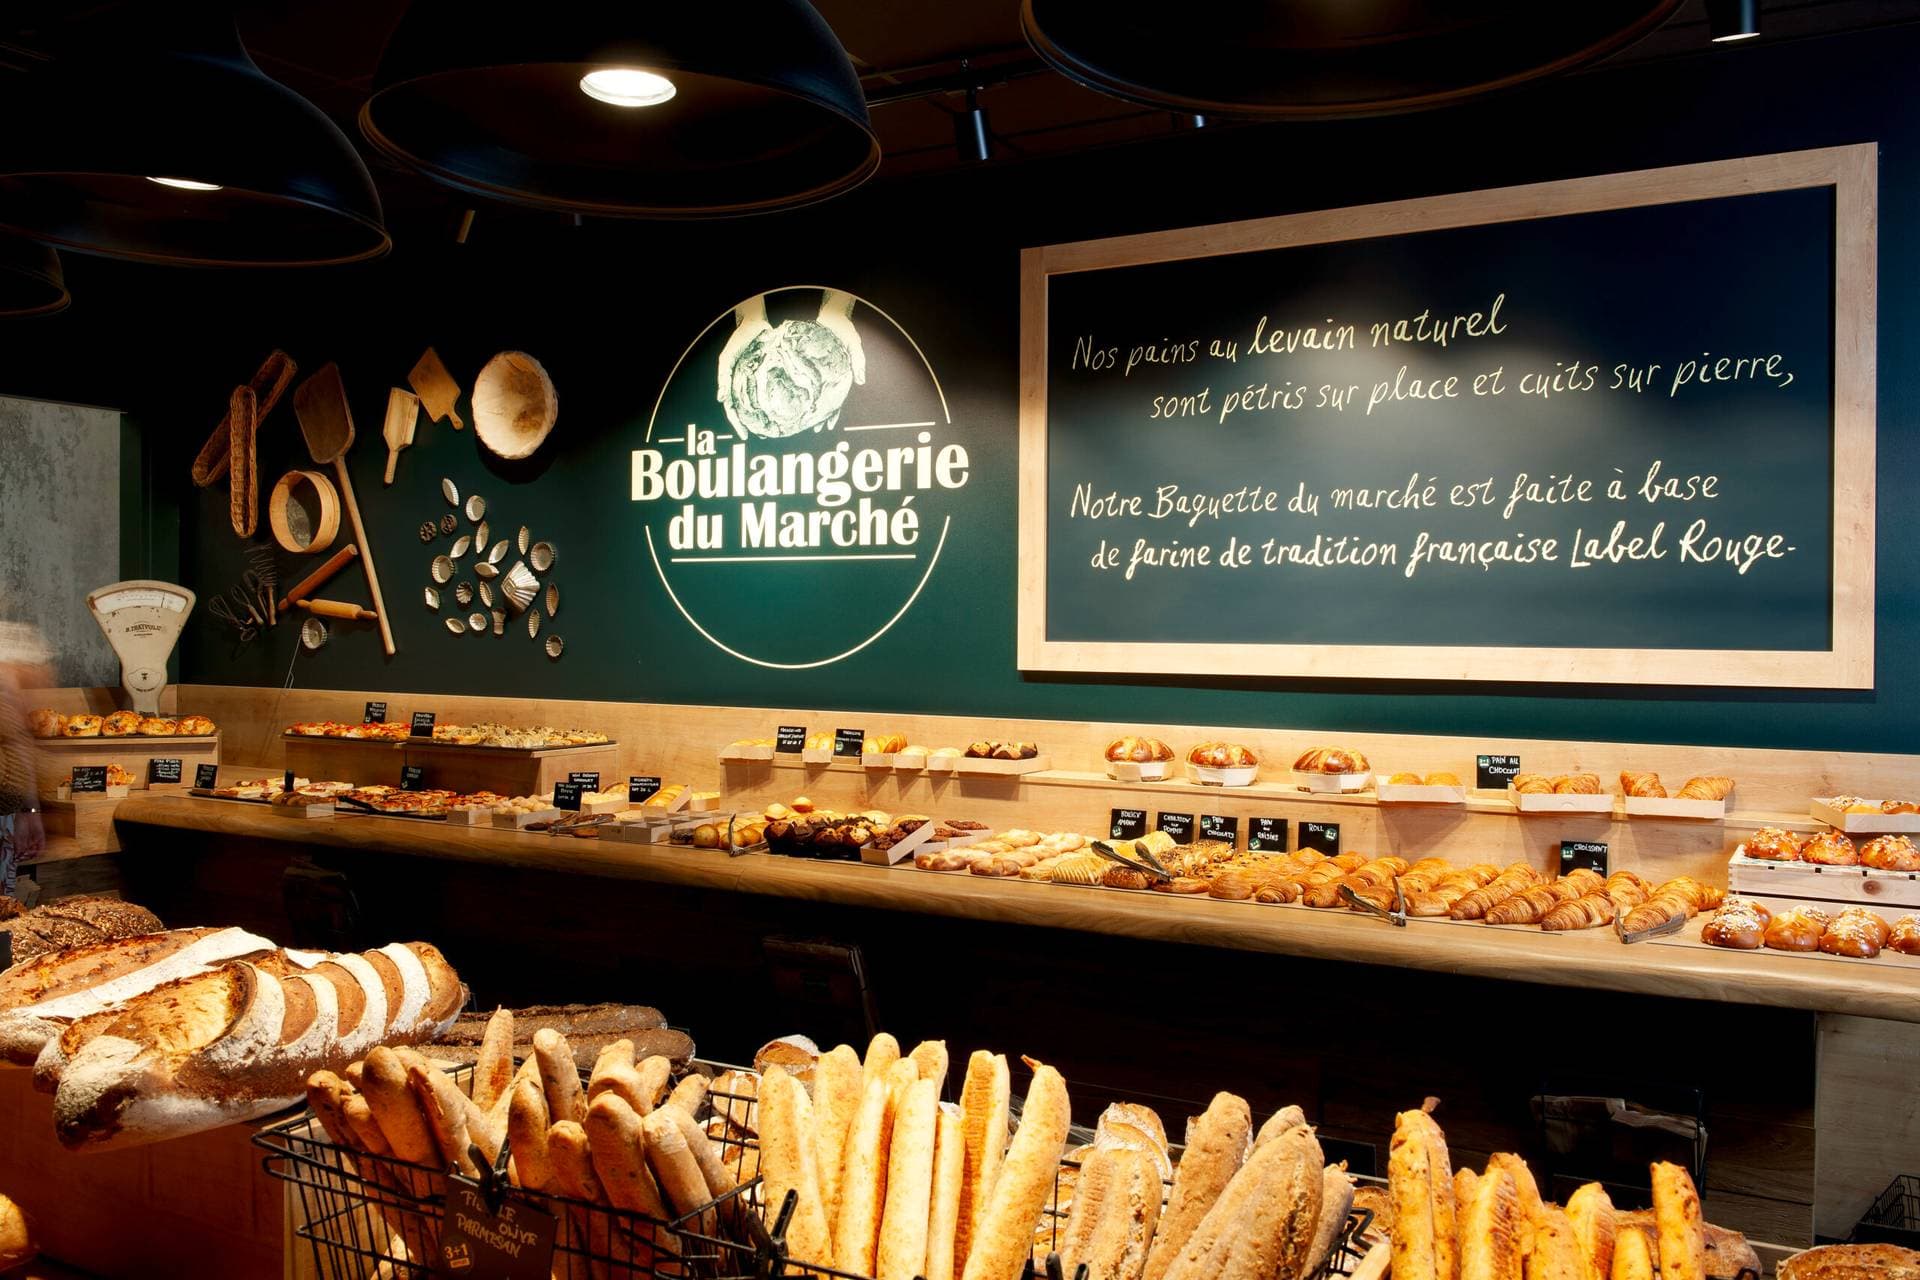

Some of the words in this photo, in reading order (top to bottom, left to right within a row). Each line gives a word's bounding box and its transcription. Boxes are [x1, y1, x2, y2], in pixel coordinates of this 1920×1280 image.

[1072, 335, 1118, 370] Nos
[1125, 338, 1199, 376] pains
[1210, 340, 1237, 363] au
[1247, 316, 1354, 355] levain
[1371, 293, 1507, 347] naturel
[1150, 387, 1211, 418] sont
[1219, 382, 1306, 424] pétris
[1316, 385, 1359, 411] sur
[1367, 366, 1458, 415] place
[1473, 366, 1505, 395] et
[1519, 361, 1598, 398] cuits
[1610, 364, 1661, 392] sur
[1671, 352, 1793, 397] pierre,
[687, 424, 717, 456] la
[631, 432, 969, 507] Boulangerie
[1607, 468, 1627, 500] à
[1638, 460, 1719, 503] base
[1071, 483, 1142, 519] Notre
[1147, 485, 1278, 528] Baguette
[1288, 482, 1319, 516] du
[1331, 473, 1437, 510] marché
[1450, 477, 1495, 507] est
[1503, 473, 1592, 519] faite
[669, 504, 723, 550] du
[741, 496, 919, 548] Marché
[1091, 540, 1120, 569] de
[1125, 539, 1211, 580] farine
[1219, 537, 1252, 568] de
[1261, 535, 1396, 567] tradition
[1491, 756, 1506, 764] PAIN
[1308, 823, 1324, 832] ROLL
[444, 1243, 468, 1260] 3+1
[456, 1212, 521, 1258] PARMESAN
